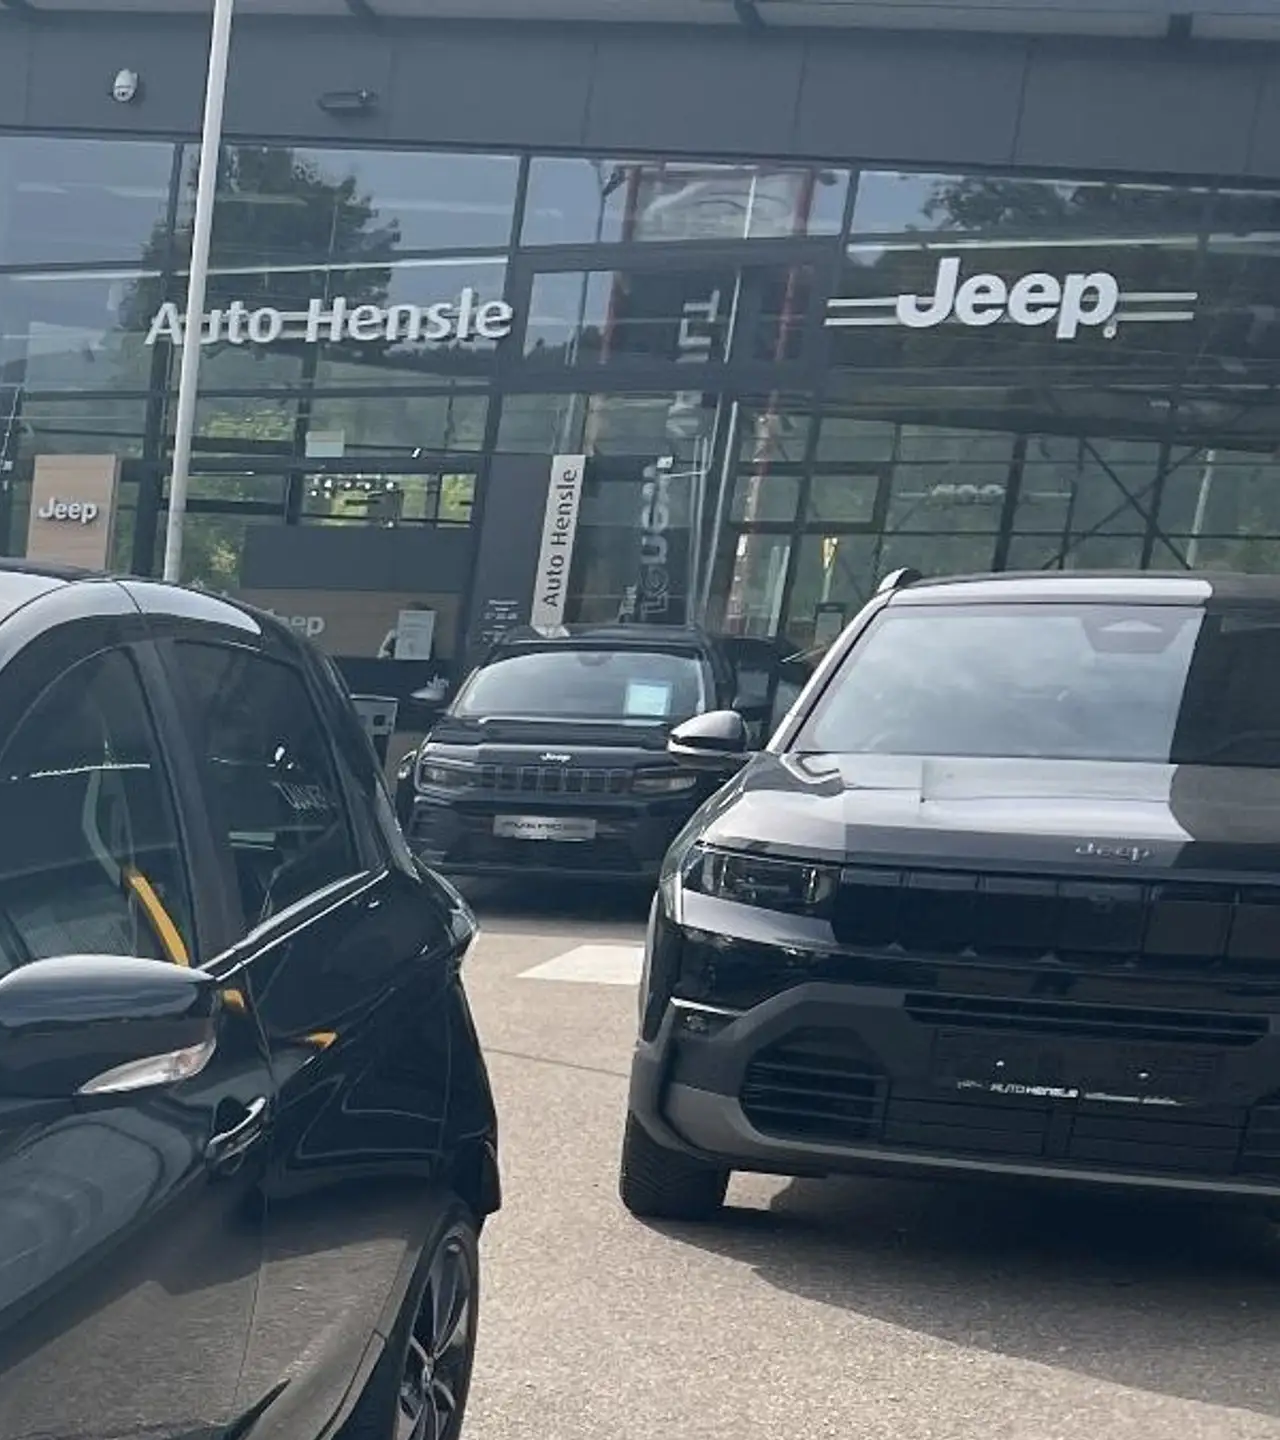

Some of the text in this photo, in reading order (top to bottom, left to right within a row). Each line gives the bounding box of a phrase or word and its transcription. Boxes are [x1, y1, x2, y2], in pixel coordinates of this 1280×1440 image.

[145, 287, 514, 347] Auto Hensle
[897, 256, 1119, 339] Jeep
[38, 497, 97, 524] Jeep
[542, 467, 578, 608] Auto Hensle
[270, 610, 325, 637] eep
